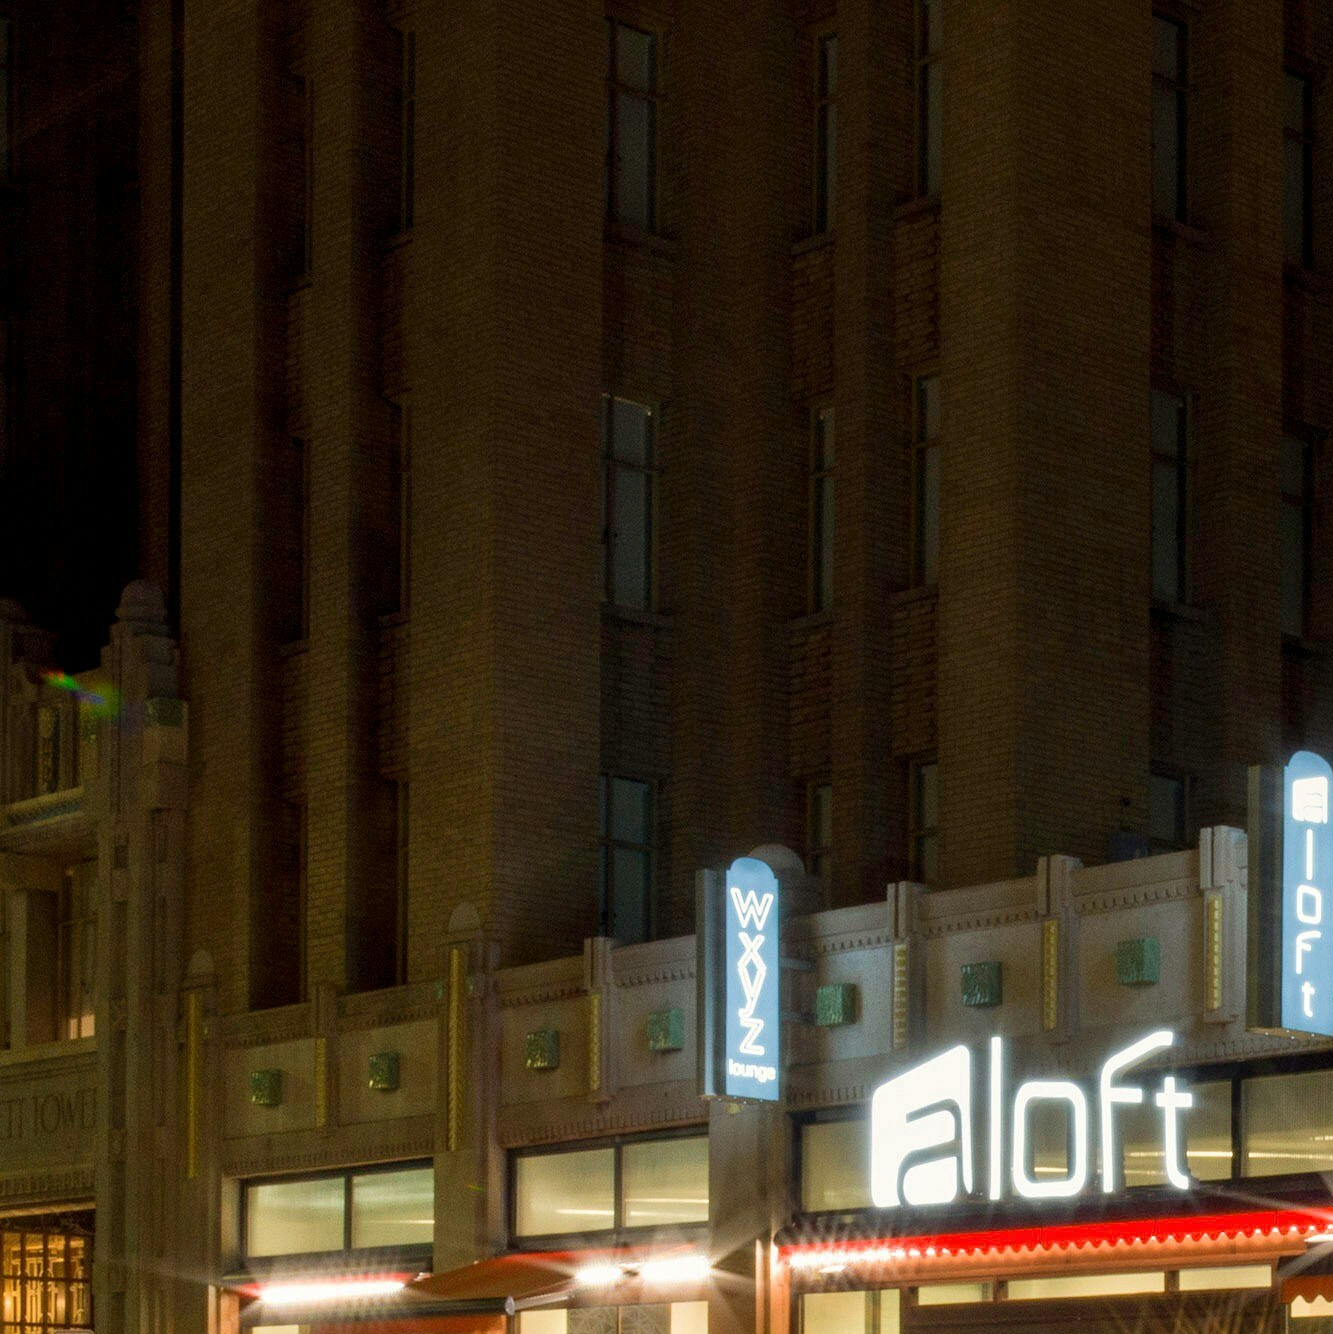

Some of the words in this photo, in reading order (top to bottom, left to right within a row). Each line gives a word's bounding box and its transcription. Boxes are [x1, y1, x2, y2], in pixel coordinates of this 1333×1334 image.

[728, 1059, 776, 1082] lounge
[31, 1087, 97, 1137] TOWE
[871, 1031, 1193, 1208] aloft
